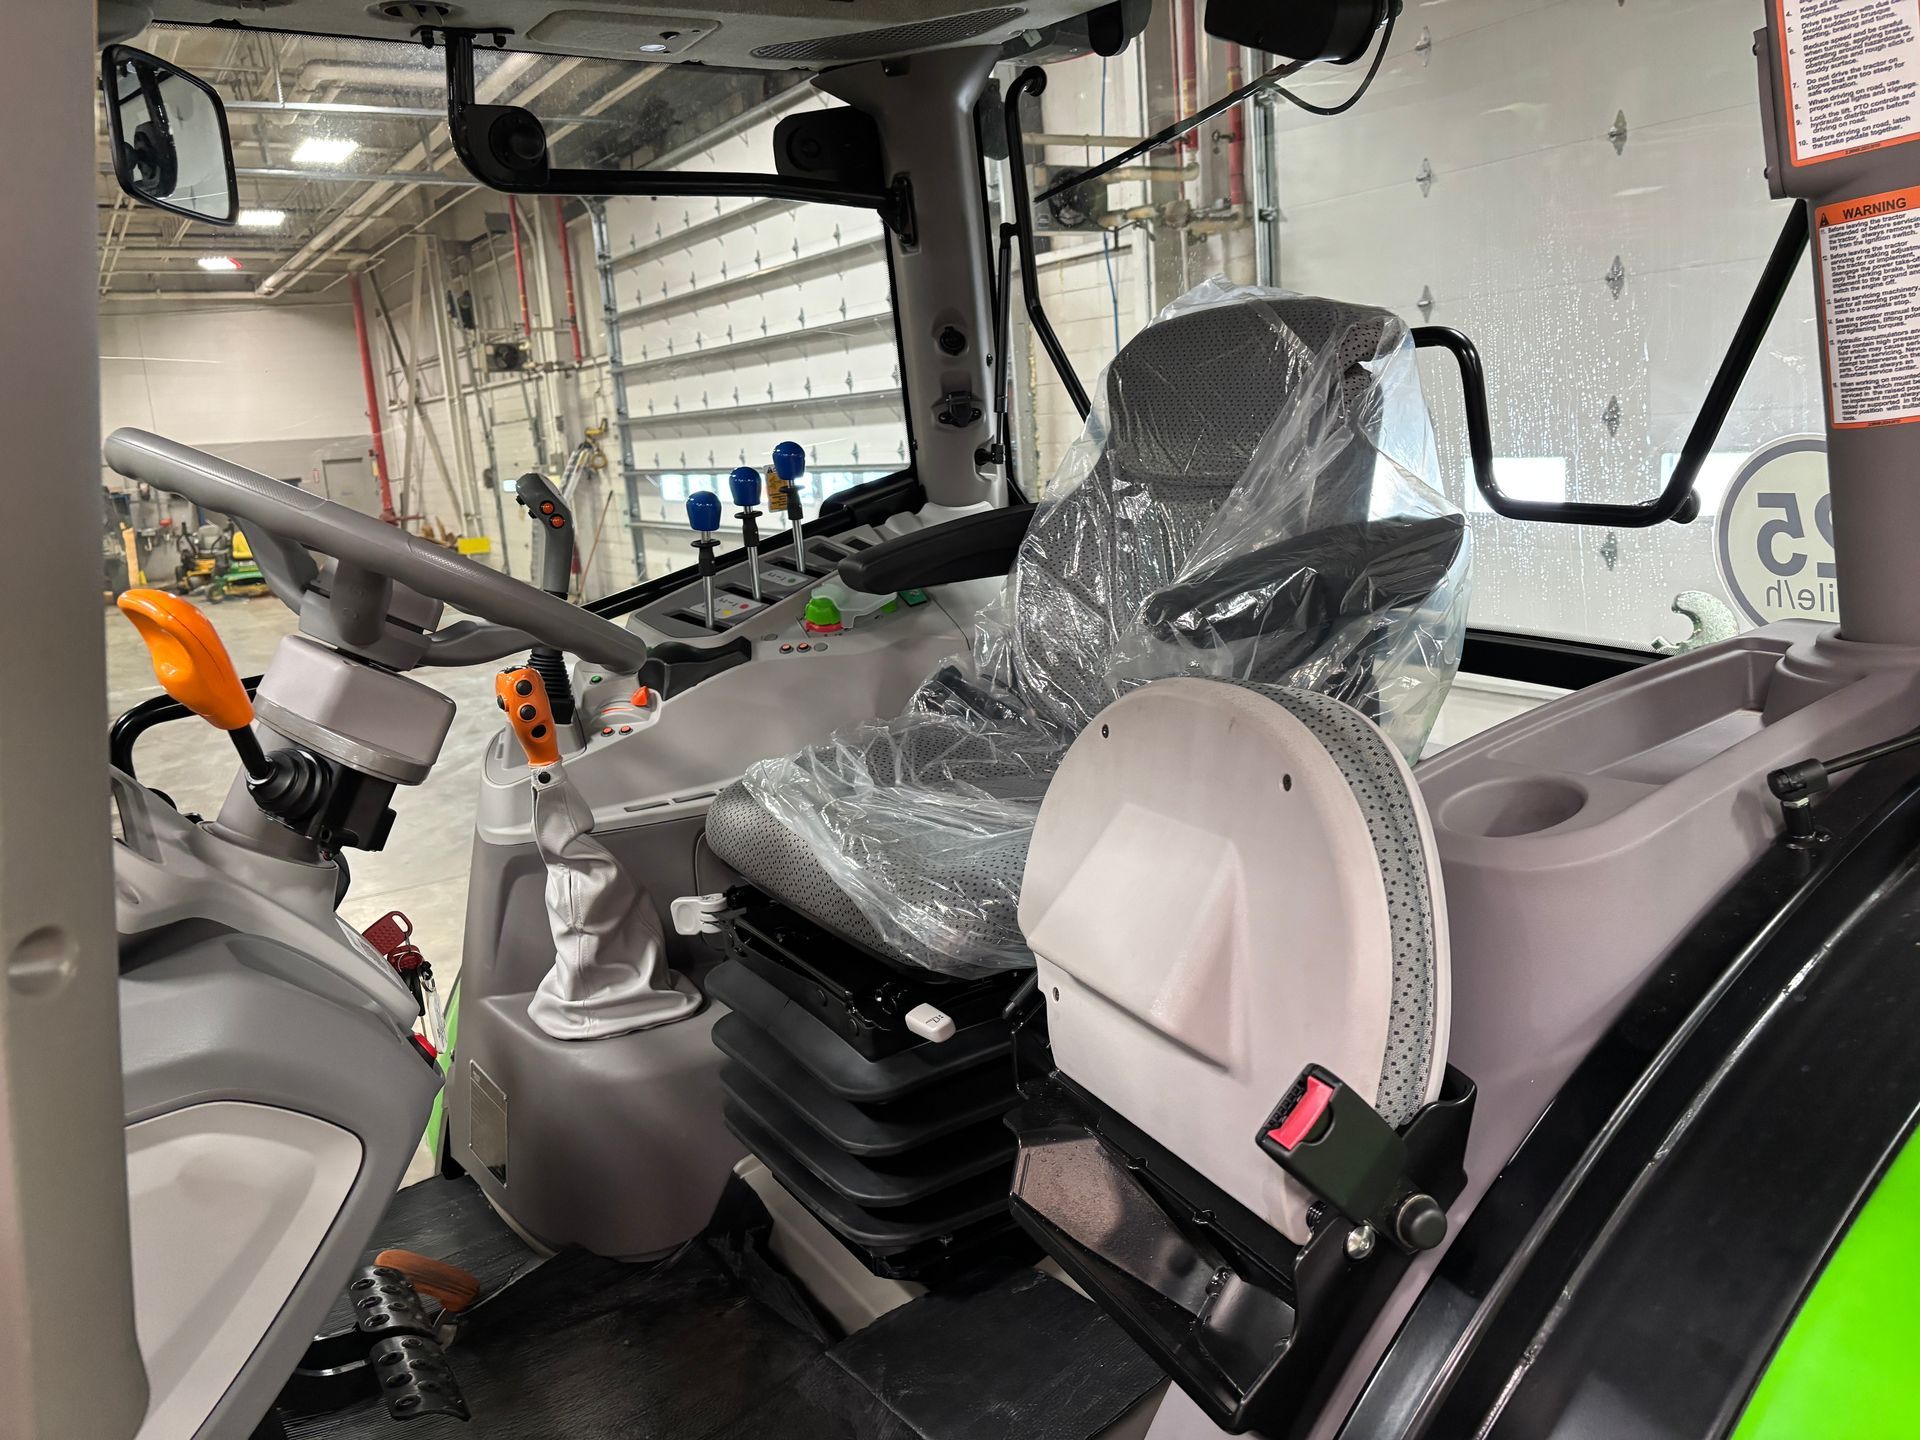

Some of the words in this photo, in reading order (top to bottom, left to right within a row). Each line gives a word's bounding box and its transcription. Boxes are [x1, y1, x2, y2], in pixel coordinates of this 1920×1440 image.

[1801, 20, 1819, 29] Drive
[1833, 9, 1857, 19] tractor
[1802, 25, 1822, 35] Avoid
[1824, 18, 1850, 28] sudden
[1832, 22, 1859, 32] braking
[1860, 17, 1874, 25] and
[1803, 41, 1829, 50] Reduce
[1830, 33, 1851, 43] speed
[1853, 29, 1866, 37] and
[1878, 19, 1902, 30] careful
[1804, 48, 1822, 56] when
[1852, 32, 1883, 43] applying
[1804, 51, 1836, 63] operating
[1838, 42, 1862, 54] around
[1864, 34, 1901, 46] hazardous
[1805, 54, 1848, 68] obstructions
[1850, 49, 1863, 57] and
[1865, 44, 1886, 53] rough
[1888, 39, 1904, 47] slick
[1806, 66, 1828, 75] muddy
[1831, 70, 1848, 78] drive
[1863, 60, 1886, 70] tractor
[1807, 81, 1829, 90] slopes
[1873, 65, 1892, 73] steep
[1829, 91, 1853, 100] driving
[1809, 103, 1831, 113] proper
[1833, 97, 1849, 105] road
[1850, 93, 1870, 101] lights
[1872, 88, 1885, 96] and
[1810, 113, 1826, 121] Lock
[1853, 102, 1868, 111] PTO
[1870, 96, 1899, 106] controls
[1901, 91, 1915, 99] and
[1810, 116, 1842, 127] hydraulic
[1844, 106, 1884, 119] distributors
[1886, 100, 1909, 109] before
[1813, 124, 1836, 133] driving
[1812, 134, 1834, 143] Before
[1836, 128, 1860, 137] driving
[1824, 138, 1844, 146] brake
[1845, 132, 1868, 142] pedals
[1870, 125, 1902, 135] together.
[1843, 198, 1906, 219] WARNING
[1846, 221, 1868, 229] leaving
[1882, 213, 1905, 221] tractor
[1861, 230, 1884, 238] always
[1865, 235, 1890, 244] ignition
[1884, 241, 1907, 249] tractor
[1864, 251, 1888, 259] making
[1872, 262, 1893, 270] power
[1857, 270, 1881, 279] parking
[1882, 271, 1907, 280] ground
[1851, 292, 1880, 300] servicing
[1889, 293, 1906, 301] parts
[1861, 302, 1891, 310] complete
[1883, 307, 1909, 315] manual
[1877, 321, 1905, 329] torques.
[1863, 331, 1908, 340] accumulators
[1867, 399, 1899, 407] supported
